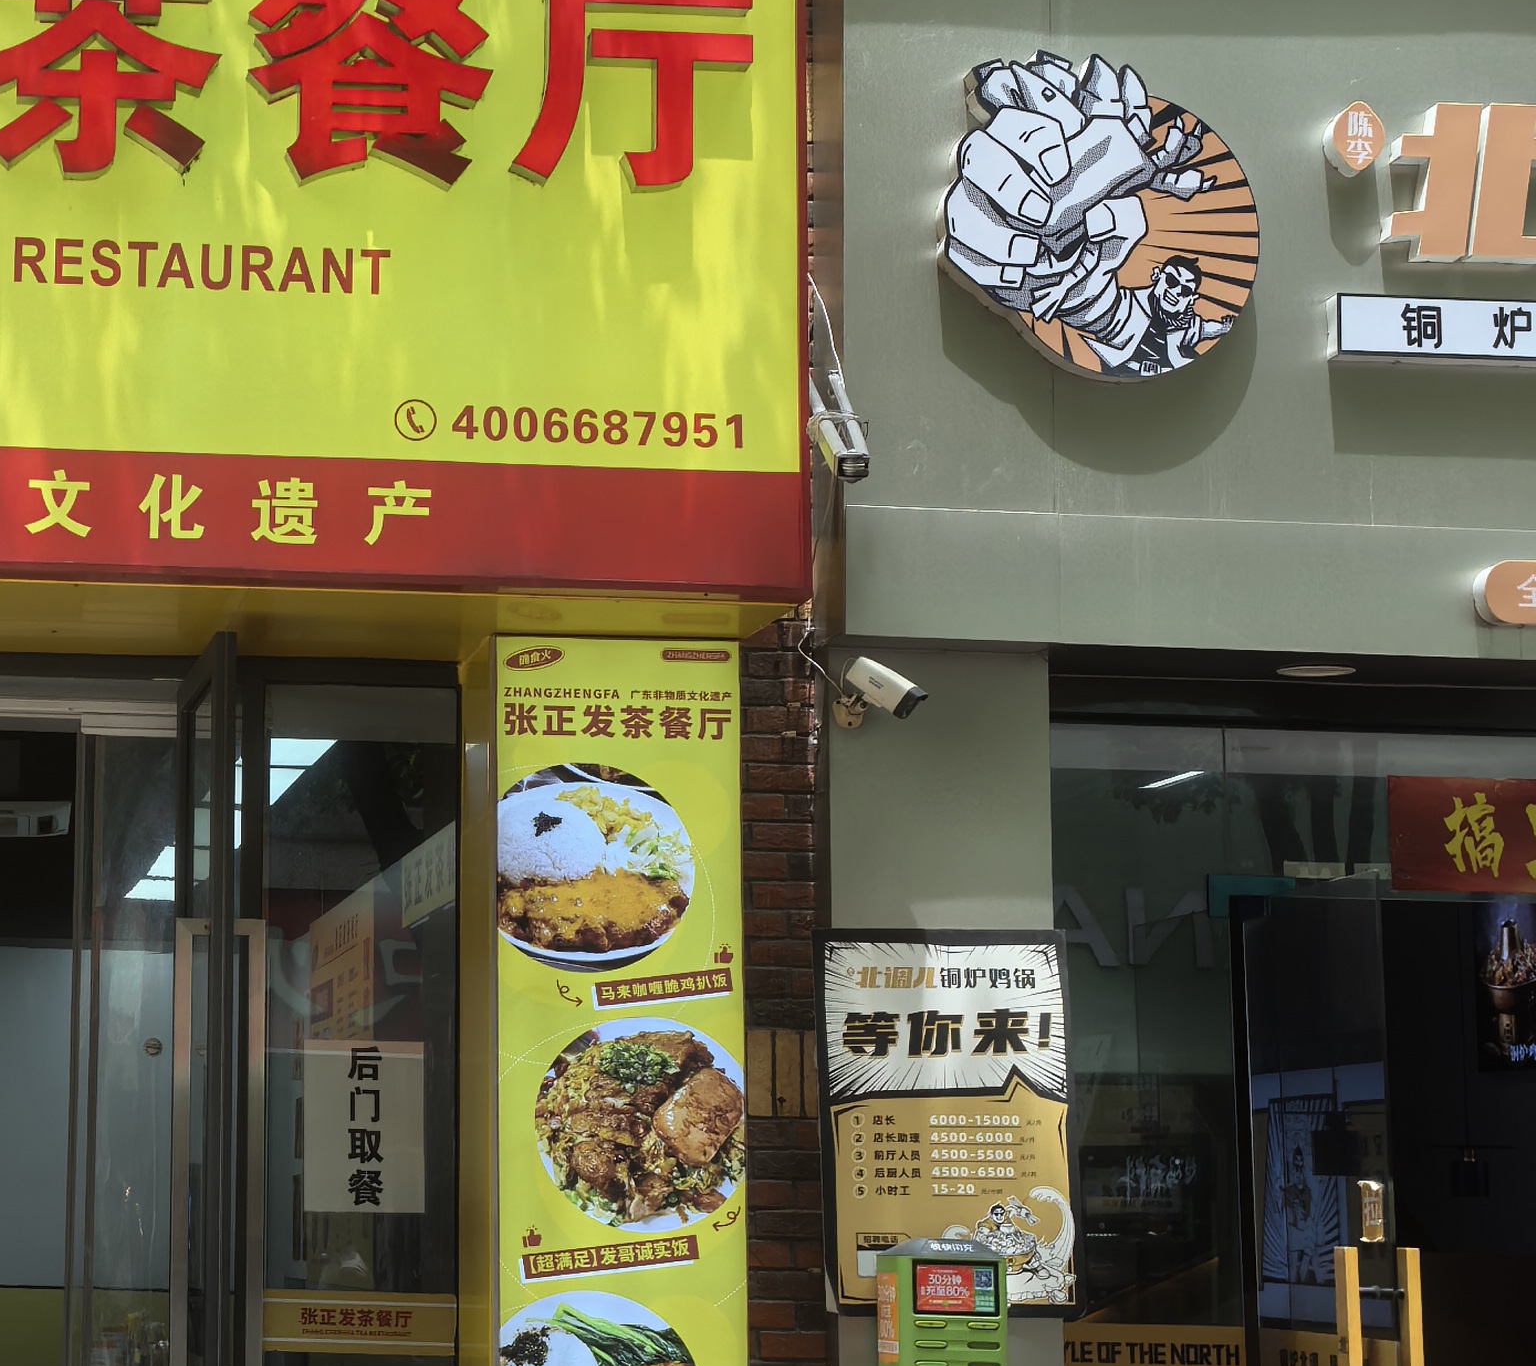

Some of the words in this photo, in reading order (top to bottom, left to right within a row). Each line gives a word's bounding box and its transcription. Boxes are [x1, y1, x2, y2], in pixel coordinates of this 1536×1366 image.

[1346, 110, 1373, 165] 陈李
[12, 235, 392, 297] RESTAURANT
[1400, 303, 1532, 350] 铜炉
[451, 404, 747, 450] 4006687951
[504, 687, 620, 700] ZHANGZHENGFA
[630, 689, 732, 702] 广东非物质文化遗产
[503, 702, 732, 741] 张正发茶餐厅
[1443, 791, 1536, 879] 搞
[599, 973, 728, 1002] 马来咖喱脆鸡扒饭
[843, 1008, 1053, 1059] 等你来!
[347, 1045, 384, 1208] 后门取餐
[872, 1115, 896, 1126] 店长
[929, 1115, 1020, 1126] 6000-15000
[873, 1132, 920, 1144] 店长助理
[930, 1132, 1013, 1143] 4500-6000
[874, 1150, 921, 1161] 前厅人员
[930, 1149, 1014, 1160] 4500-5500
[874, 1167, 921, 1179] 后厨人员
[931, 1166, 1015, 1177] 4500-6500
[875, 1185, 910, 1196] 小时工
[932, 1183, 975, 1195] 15-20
[300, 1307, 413, 1330] 张正发茶餐厅
[1096, 1341, 1122, 1364] OF
[1125, 1341, 1167, 1365] THE
[1170, 1342, 1240, 1366] NORTH
